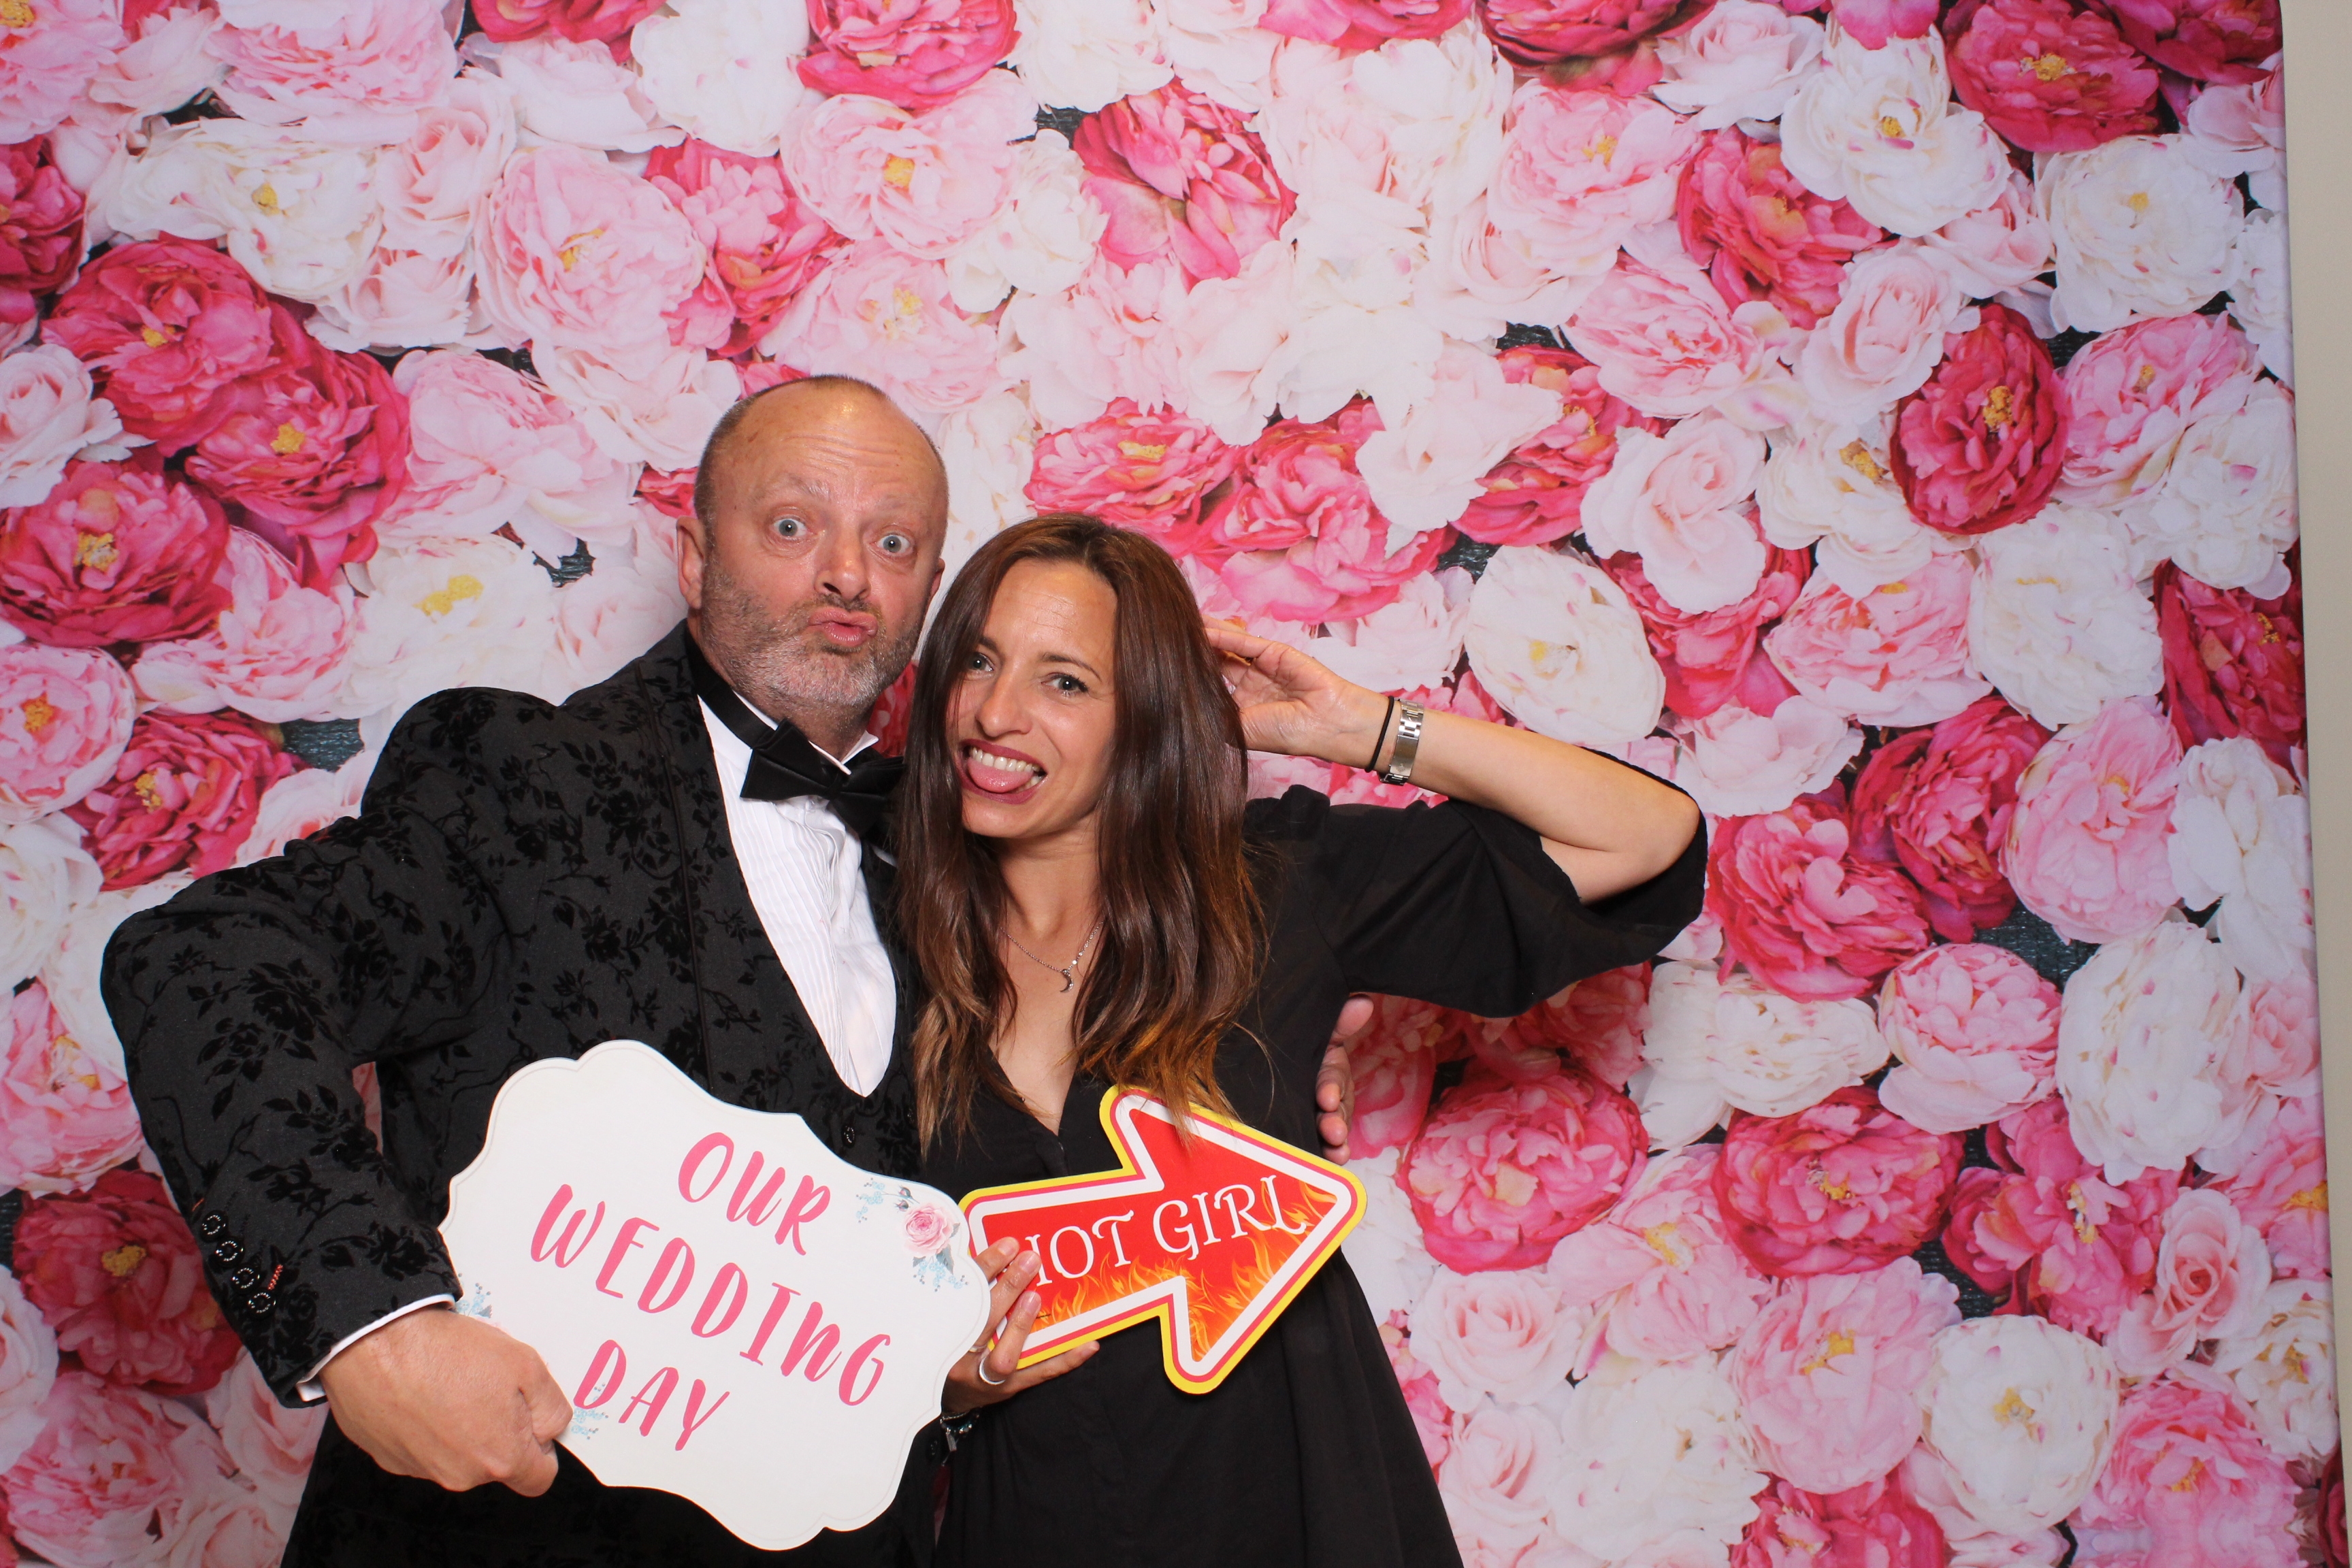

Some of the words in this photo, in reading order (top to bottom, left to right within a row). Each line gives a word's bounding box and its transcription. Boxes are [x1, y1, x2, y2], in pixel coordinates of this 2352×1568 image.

[679, 1132, 831, 1256] OUR
[1153, 1175, 1308, 1260] GIRL
[531, 1183, 891, 1406] WEDDING
[573, 1339, 730, 1451] DAY
